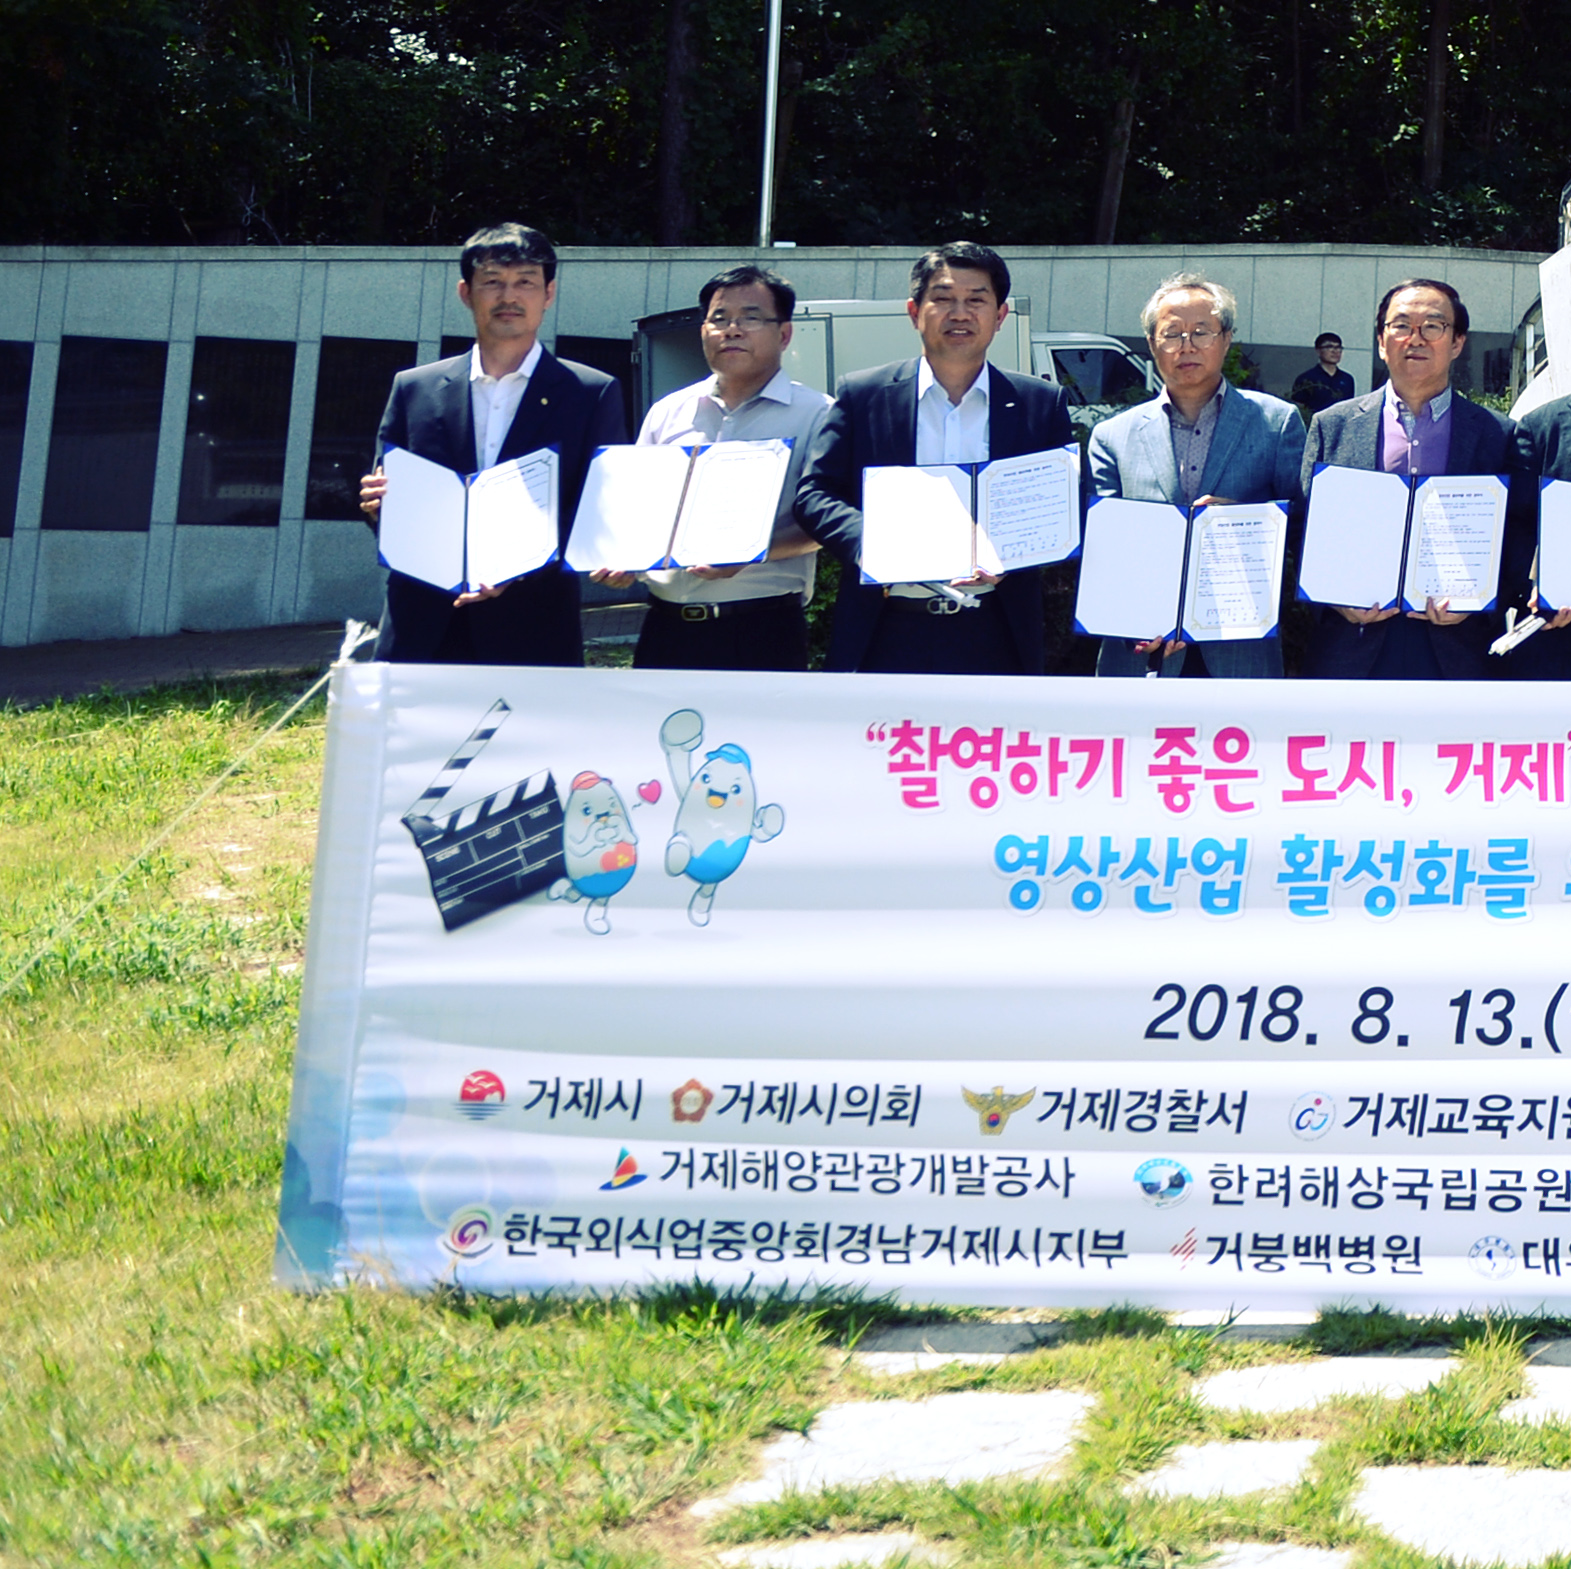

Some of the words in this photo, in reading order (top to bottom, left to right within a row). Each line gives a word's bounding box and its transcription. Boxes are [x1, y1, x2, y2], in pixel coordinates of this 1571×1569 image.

[865, 719, 1125, 810] “촬영하기
[1147, 726, 1259, 814] 좋은
[1281, 734, 1413, 808] 도시,
[993, 833, 1249, 916] 영상산업
[1276, 833, 1536, 920] 활성화를
[1143, 982, 1318, 1046] 2018.
[1350, 985, 1410, 1048] 8.
[522, 1076, 643, 1122] 거제시
[715, 1080, 922, 1128] 거제시의회
[1035, 1086, 1249, 1135] 거제경찰서
[659, 1147, 1077, 1200] 거제해양관광개발공사
[502, 1213, 1130, 1270] 한국외식업중앙회경남거제시지부
[1206, 1231, 1424, 1275] 거붕백병원
